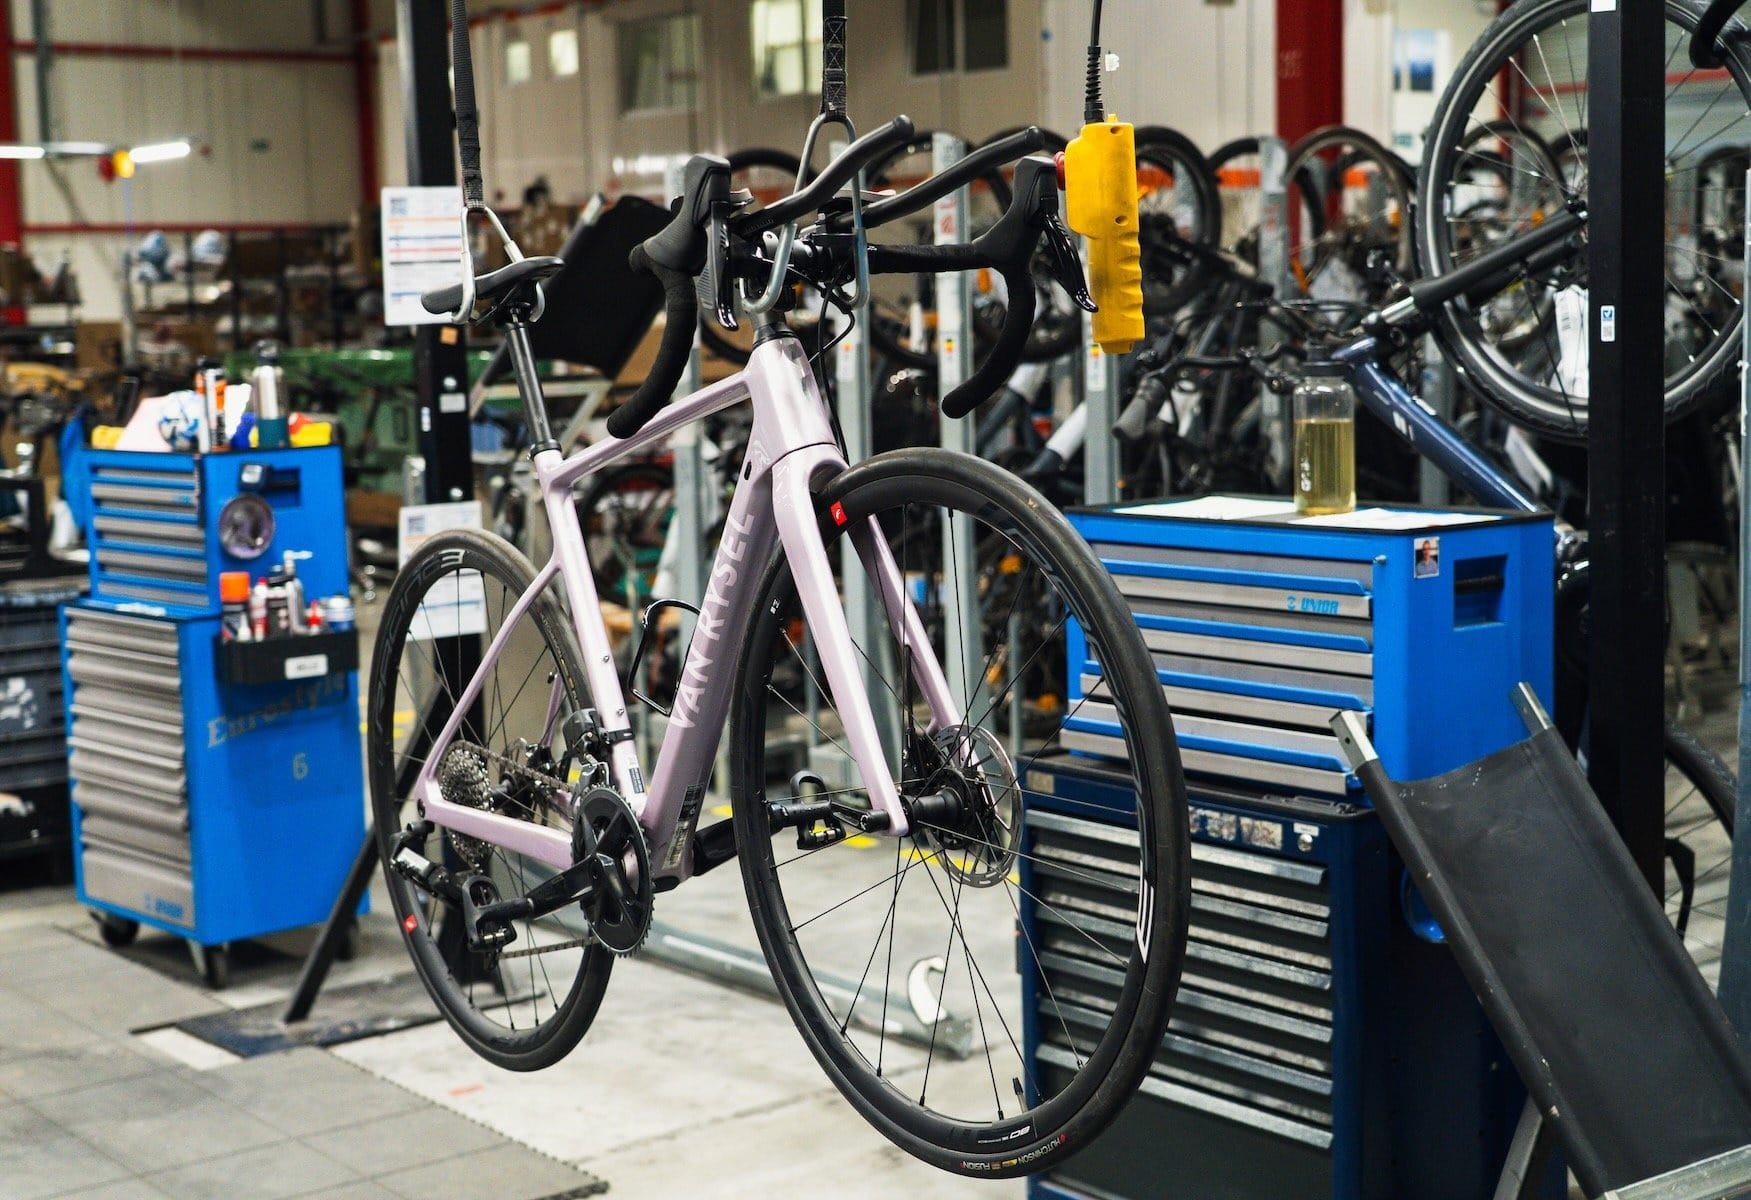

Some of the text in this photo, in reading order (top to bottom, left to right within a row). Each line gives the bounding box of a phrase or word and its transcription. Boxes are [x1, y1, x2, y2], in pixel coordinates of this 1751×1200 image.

[670, 514, 755, 729] VAN RYSEL
[293, 752, 308, 780] 6
[963, 1138, 1061, 1171] HUTCHINSON FUSION
